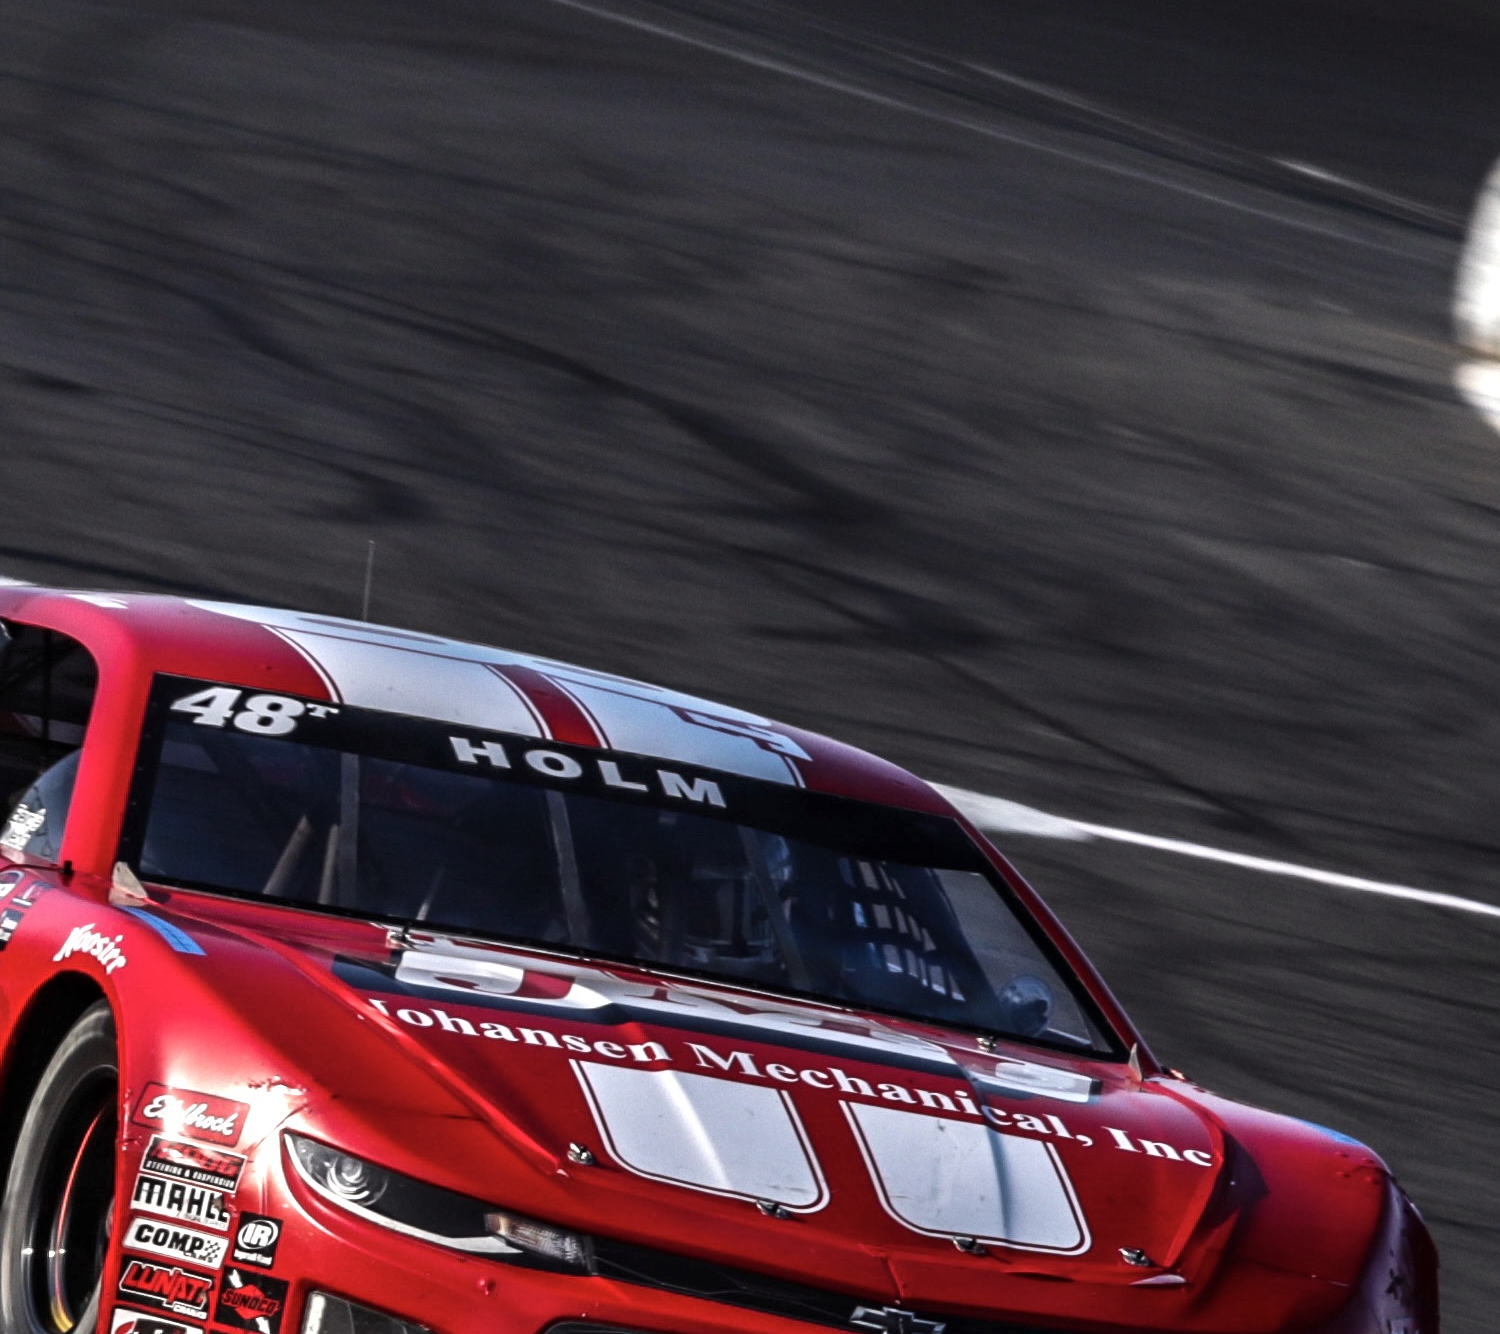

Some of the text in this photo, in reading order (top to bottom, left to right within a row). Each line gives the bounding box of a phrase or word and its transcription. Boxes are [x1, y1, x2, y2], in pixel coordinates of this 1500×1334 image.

[447, 736, 726, 808] HOLM
[53, 923, 126, 975] Hoosier
[368, 998, 1213, 1167] Johansen Mechanical, Inc
[143, 1095, 239, 1136] Elbrock
[145, 1160, 182, 1175] STEERING
[192, 1171, 235, 1189] SUSPENSION
[135, 1223, 205, 1253] COMP
[243, 1223, 272, 1247] IR
[222, 1288, 279, 1317] SUNOCO
